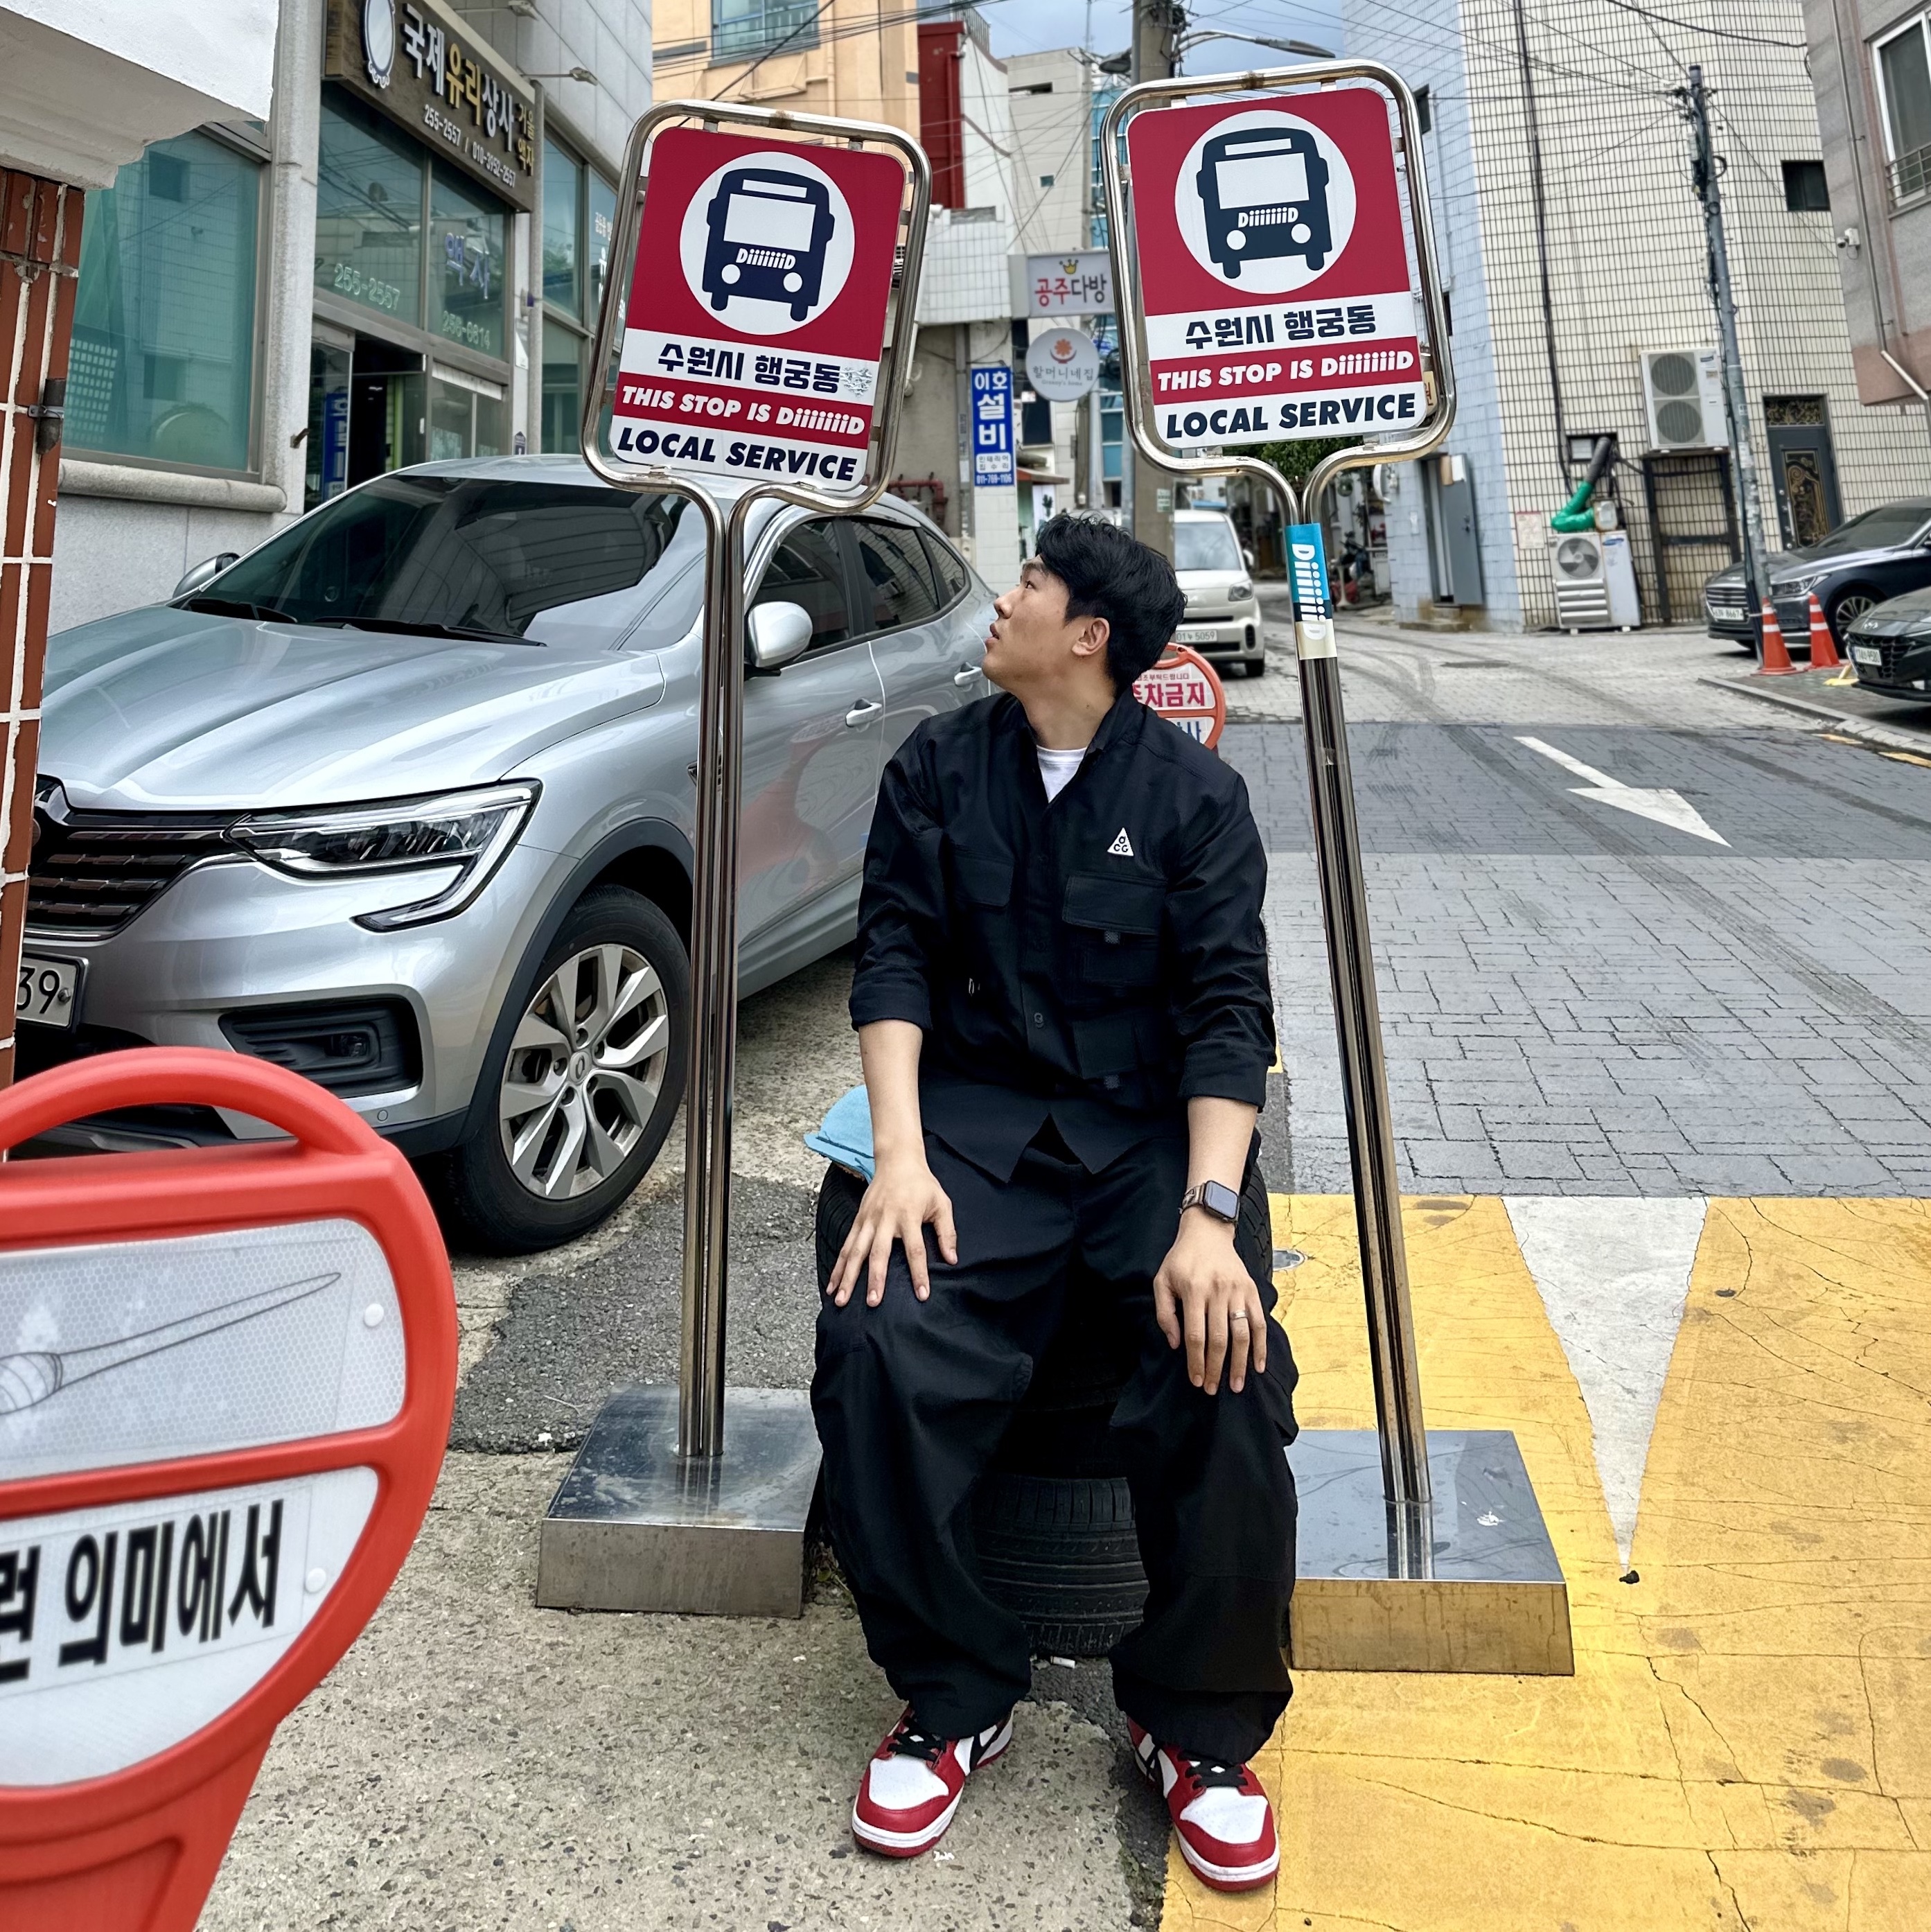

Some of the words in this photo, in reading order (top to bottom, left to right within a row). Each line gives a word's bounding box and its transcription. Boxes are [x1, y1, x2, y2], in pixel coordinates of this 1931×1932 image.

[403, 3, 514, 152] 국제유리상사
[424, 104, 461, 146] 255-2557
[519, 104, 535, 141] 거울
[518, 139, 534, 176] 액자
[335, 263, 400, 310] 255-2557
[1034, 274, 1106, 307] 공주다방
[1186, 314, 1274, 349] 수원시
[1283, 305, 1376, 340] 행궁동
[658, 343, 744, 380] 수원시
[755, 355, 840, 394] 행궁동
[975, 371, 1008, 390] 이호
[1032, 366, 1094, 381] 할머니네집
[1158, 369, 1211, 392] THIS
[1218, 362, 1281, 386] STOP
[1289, 360, 1313, 380] IS
[622, 385, 674, 409] THIS
[679, 394, 741, 416] STOP
[746, 403, 771, 423] IS
[978, 393, 1007, 450] 설비
[1166, 407, 1268, 439] LOCAL
[1279, 393, 1415, 428] SERVICE
[617, 428, 716, 462] LOCAL
[725, 442, 857, 482] SERVICE
[1195, 631, 1215, 640] 5059
[58, 1499, 284, 1667] 의미에서
